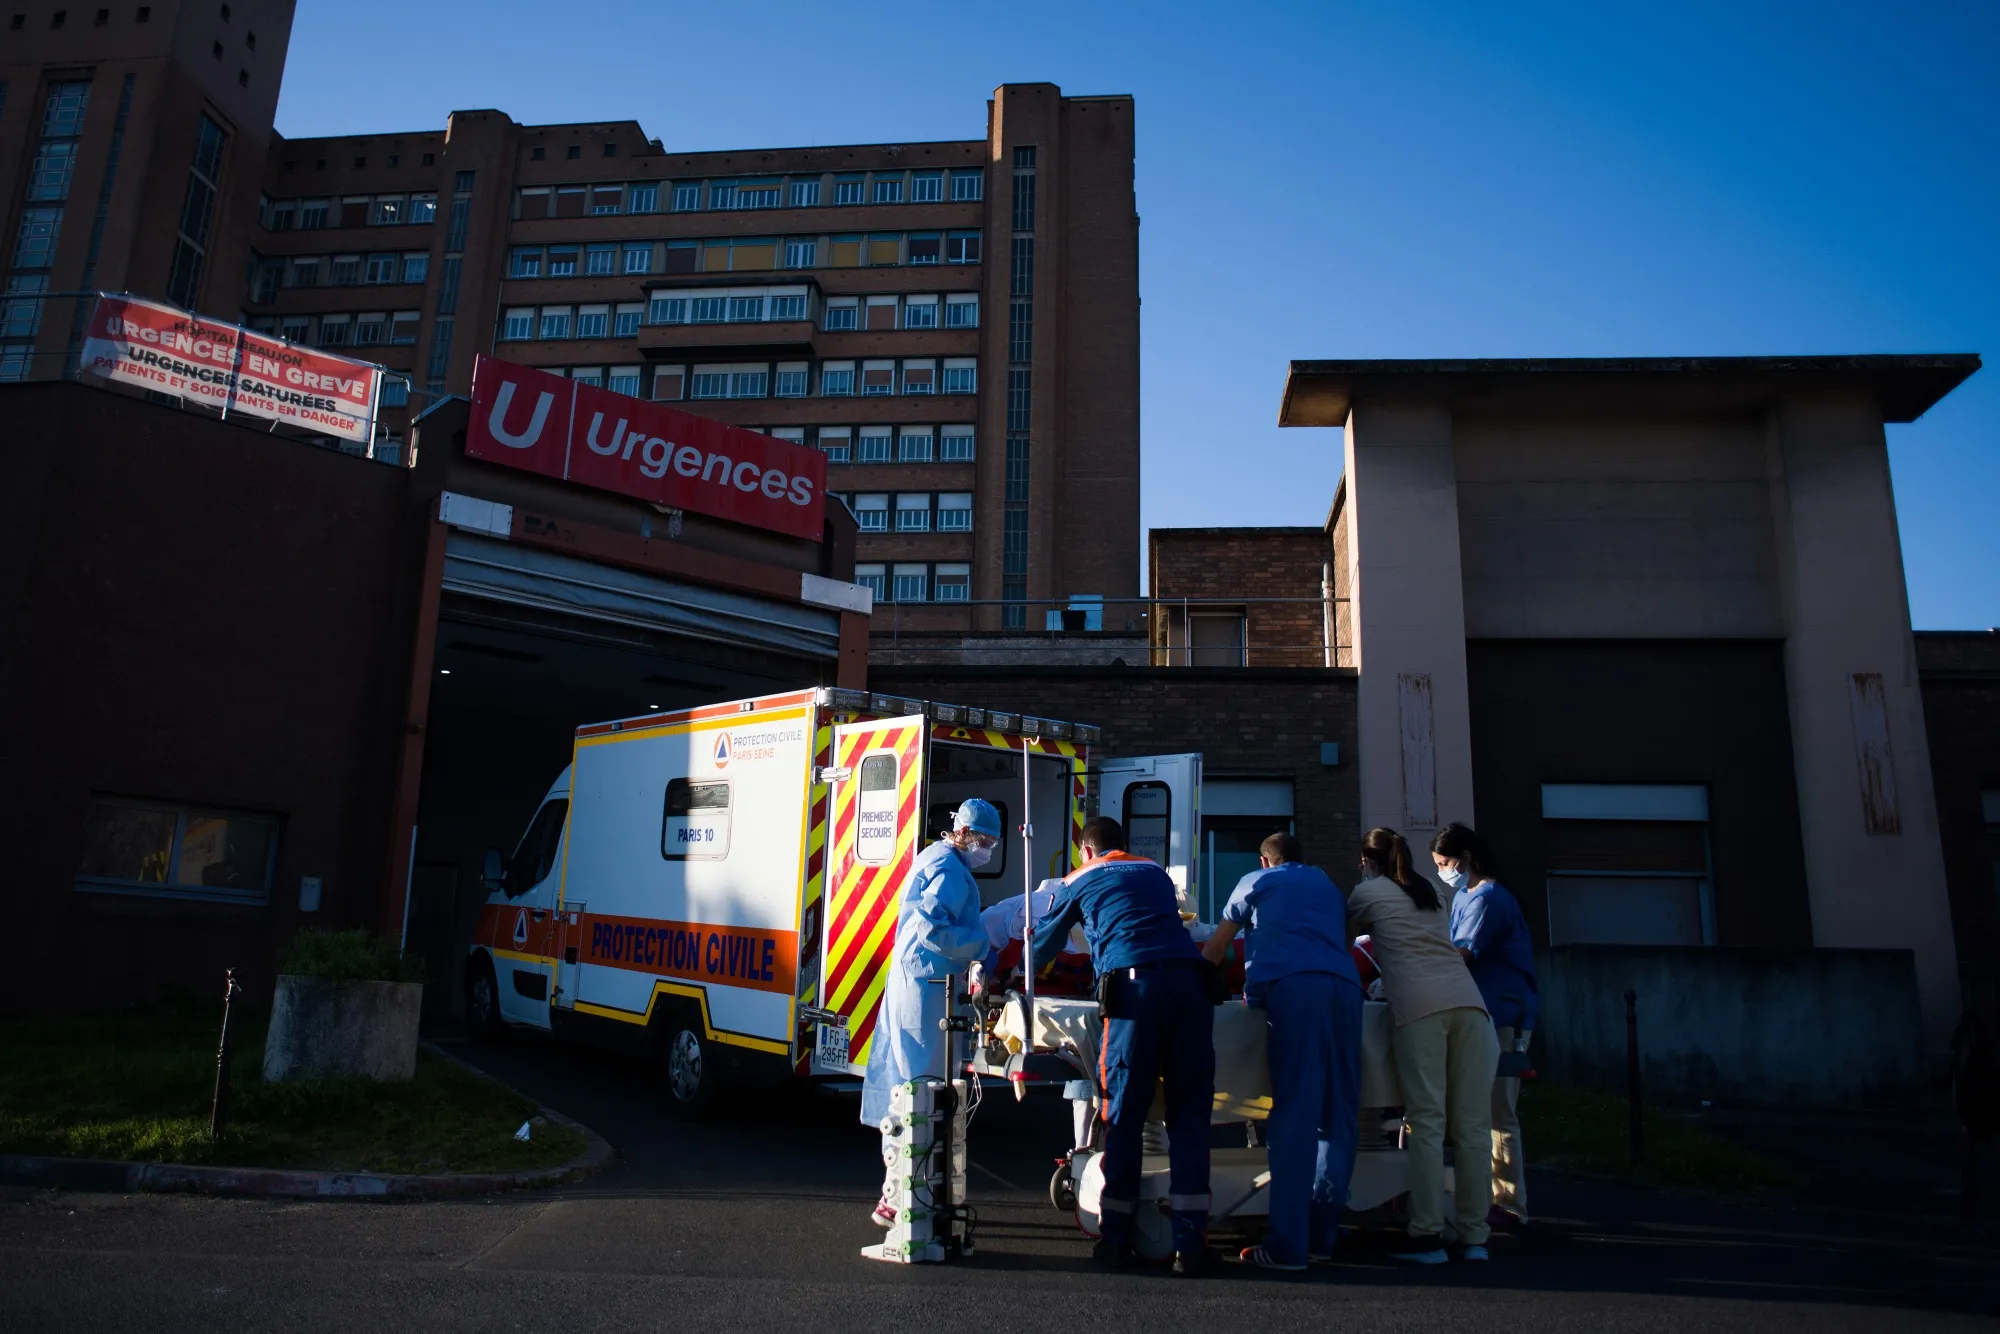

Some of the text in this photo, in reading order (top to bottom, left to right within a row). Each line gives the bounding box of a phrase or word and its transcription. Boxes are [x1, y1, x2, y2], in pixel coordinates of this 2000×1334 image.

[106, 316, 365, 399] URGENCES EN GREVE
[242, 340, 302, 366] BEAUJON
[94, 356, 355, 432] PATIENTS ET SOIGNANTS EN DANGER
[128, 346, 337, 413] URGENCES SATURÉES
[488, 381, 555, 449] U
[586, 412, 814, 506] Urgences
[732, 747, 775, 761] PARIS SEINE
[733, 729, 803, 747] PROTECTION CIVILE
[678, 828, 714, 842] PARIS 10
[861, 811, 894, 823] PREMIERS
[861, 827, 892, 839] SECOURS
[591, 922, 776, 982] PROTECTION CIVILE
